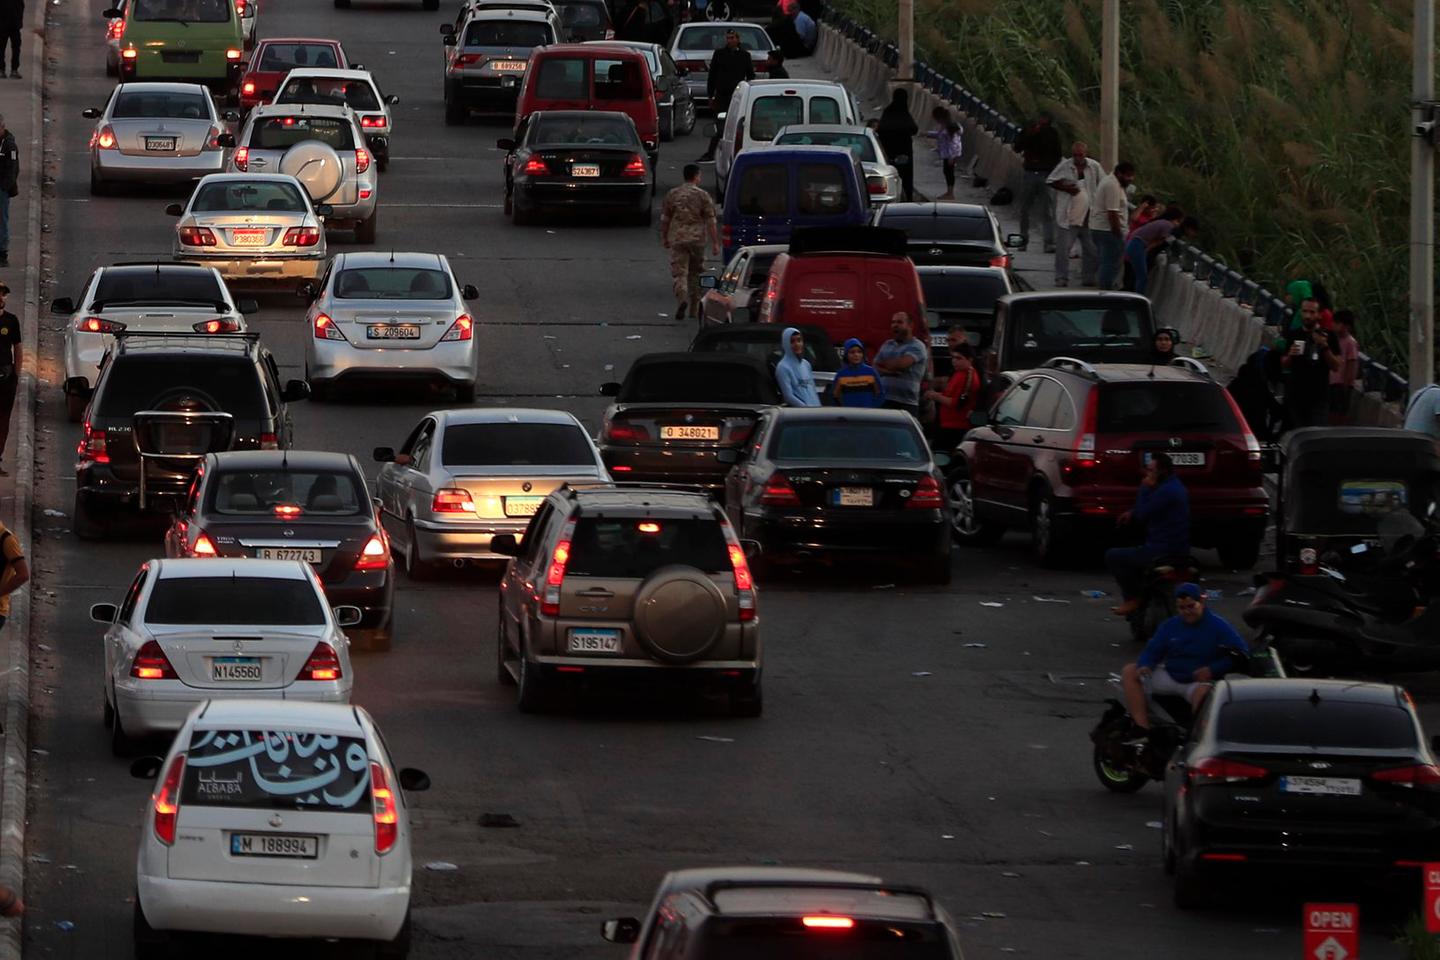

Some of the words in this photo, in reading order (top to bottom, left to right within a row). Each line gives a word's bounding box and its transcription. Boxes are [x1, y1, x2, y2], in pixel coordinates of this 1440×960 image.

[374, 328, 379, 337] S
[384, 328, 414, 337] 209604
[679, 428, 712, 438] 348021
[277, 550, 315, 561] 672743
[572, 636, 617, 650] S195147
[214, 666, 261, 678] N145560
[197, 782, 242, 794] ALBABA
[242, 837, 252, 851] M
[262, 838, 307, 853] 188994
[1310, 911, 1352, 929] OPEN
